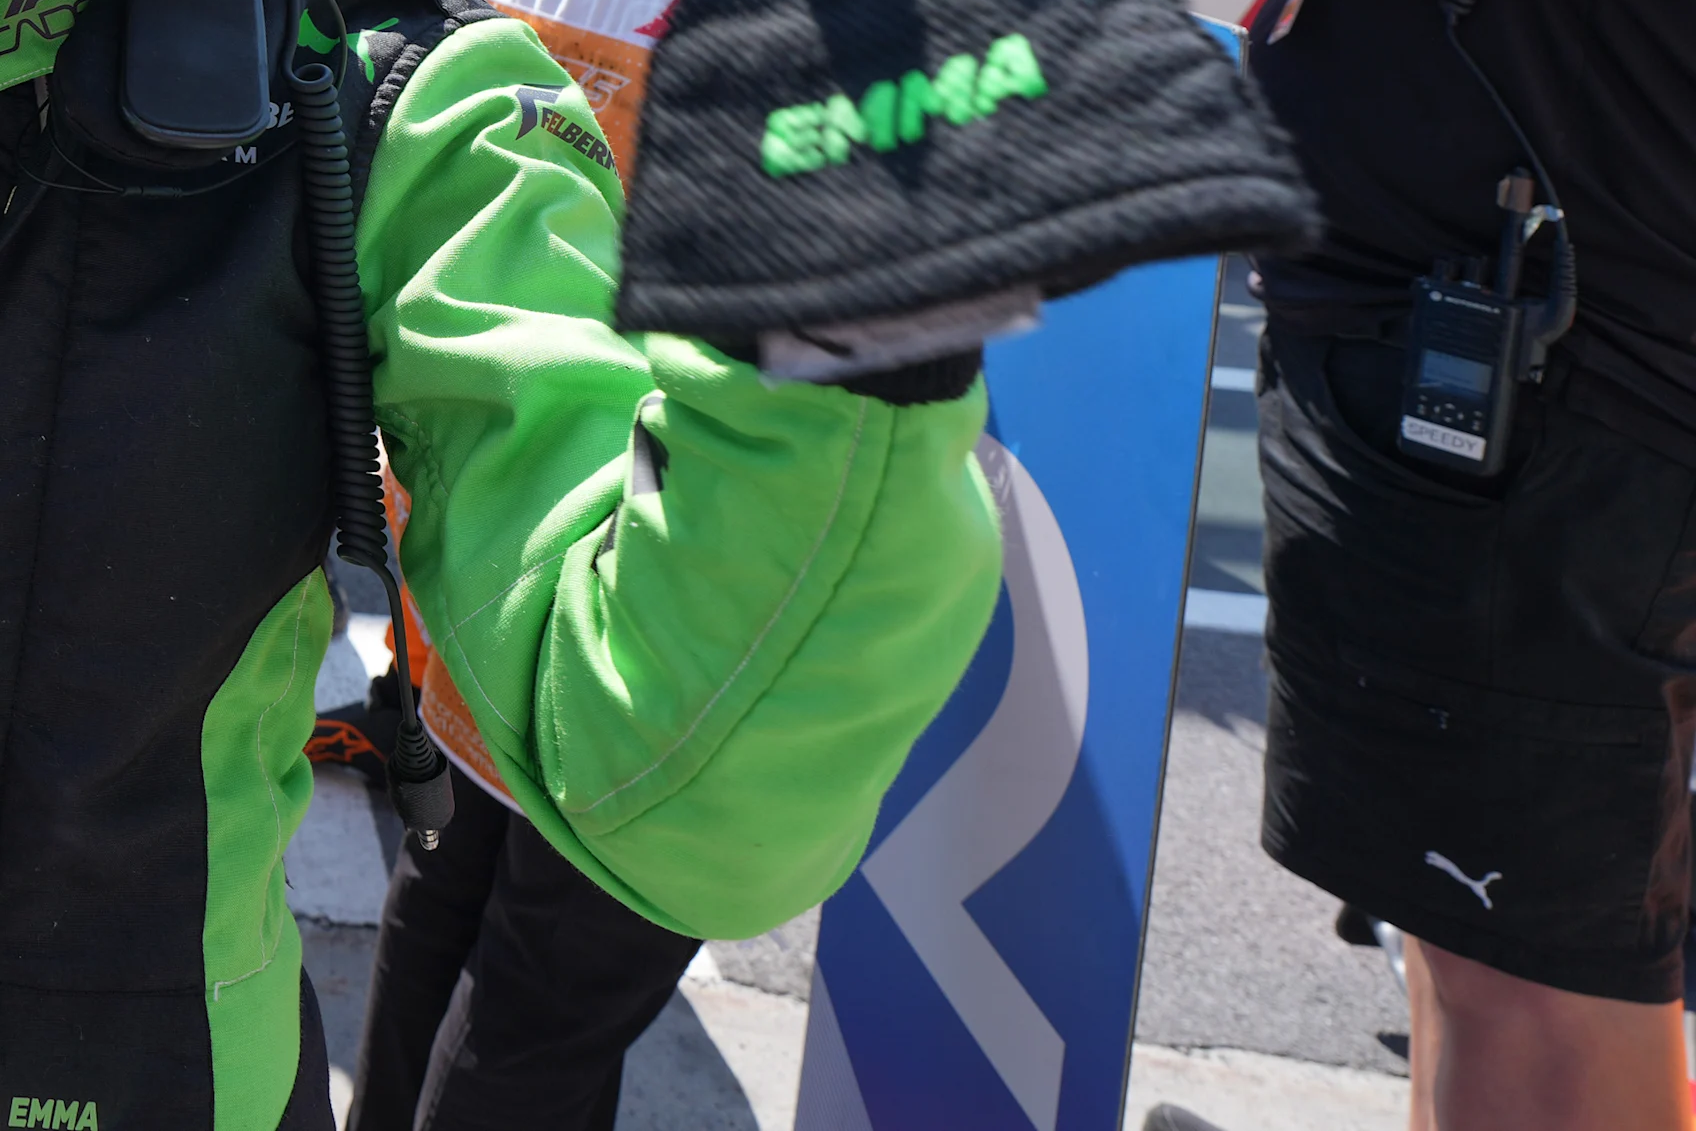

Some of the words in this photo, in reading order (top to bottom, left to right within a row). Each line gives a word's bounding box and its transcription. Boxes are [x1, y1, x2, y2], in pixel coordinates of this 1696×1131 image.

[760, 33, 1049, 178] EMMA
[1407, 421, 1480, 454] SPEEDY
[8, 1096, 99, 1131] EMMA
